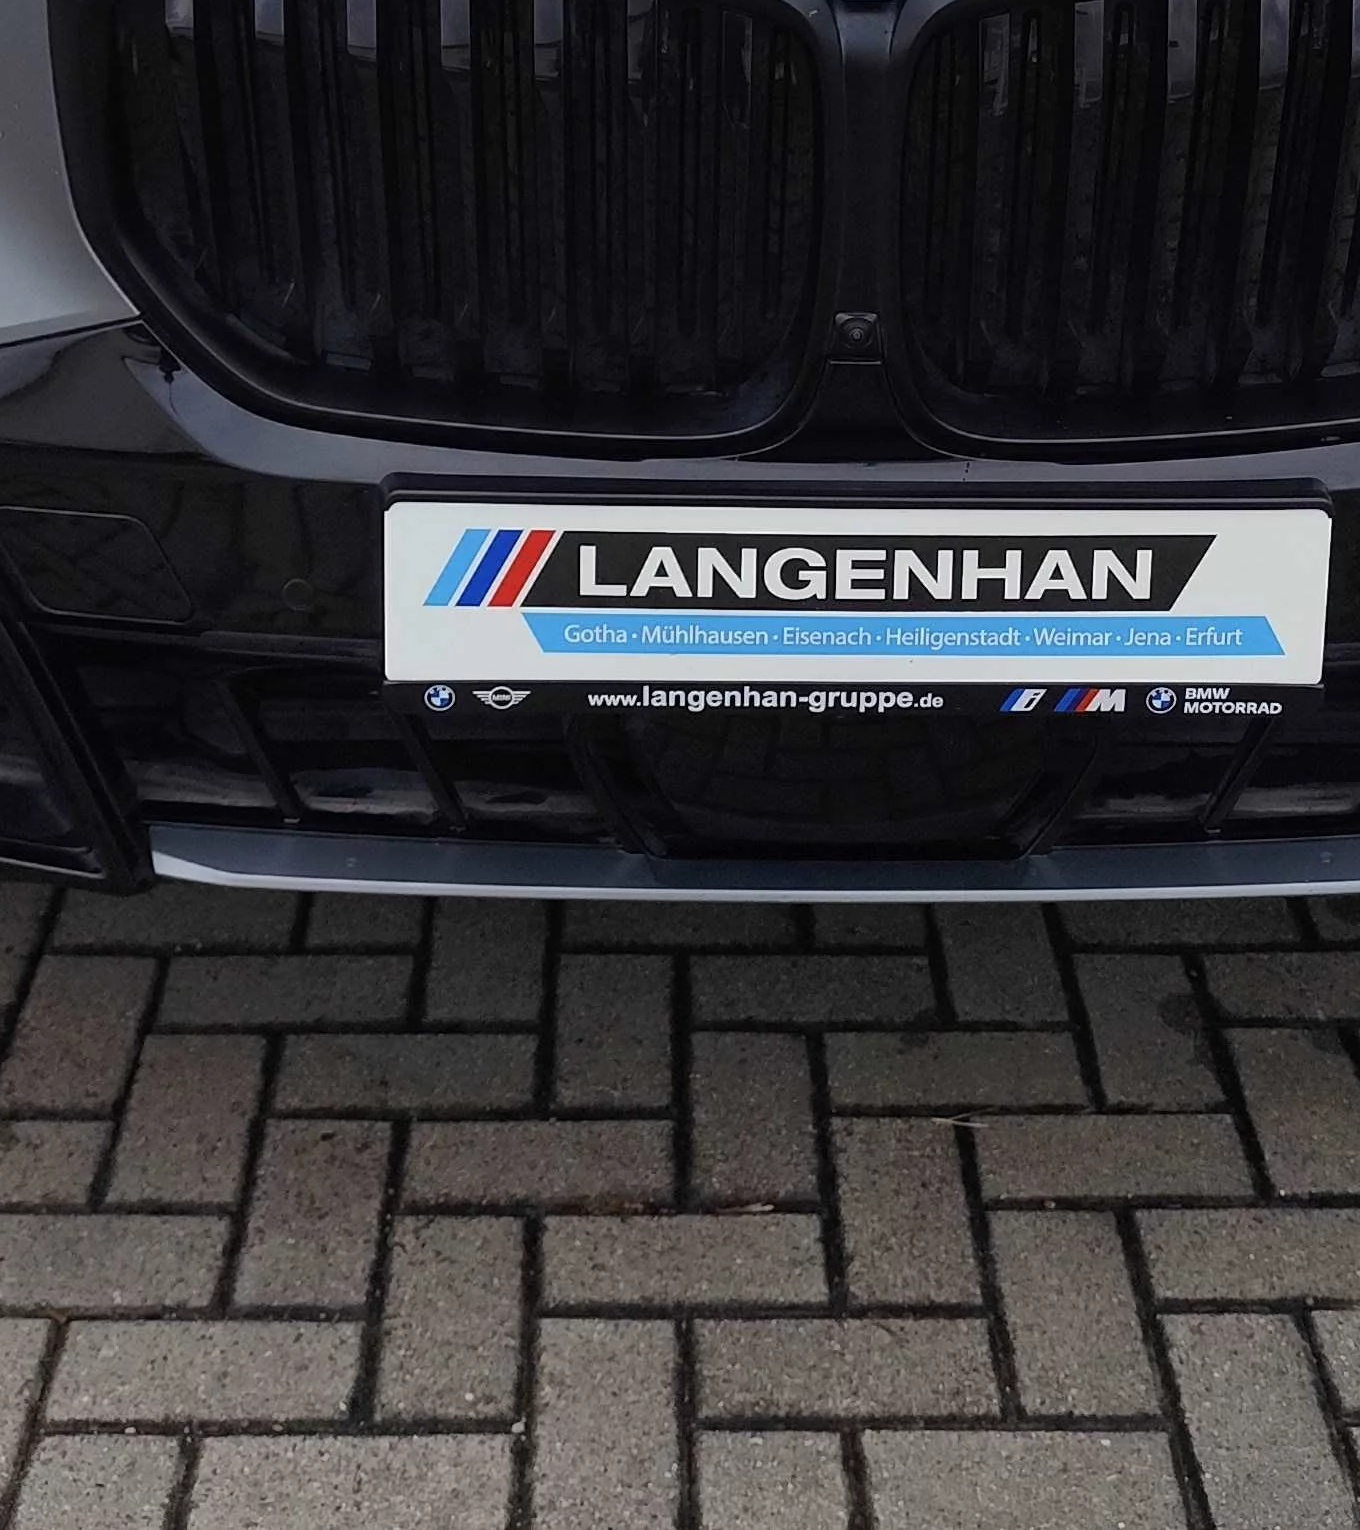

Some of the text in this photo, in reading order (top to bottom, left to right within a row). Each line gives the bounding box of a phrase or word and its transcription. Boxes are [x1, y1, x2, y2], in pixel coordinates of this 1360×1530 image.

[578, 545, 1153, 601] LANGENHAN
[563, 624, 1243, 650] Gotha Mühlhausen Eisenach Heiligenstadt Weimar Jena Erfurt
[587, 685, 944, 713] www.langenhan-gruppe.de
[1084, 688, 1126, 712] M
[1184, 687, 1231, 700] BMW
[1183, 701, 1283, 715] MOTORRAD
